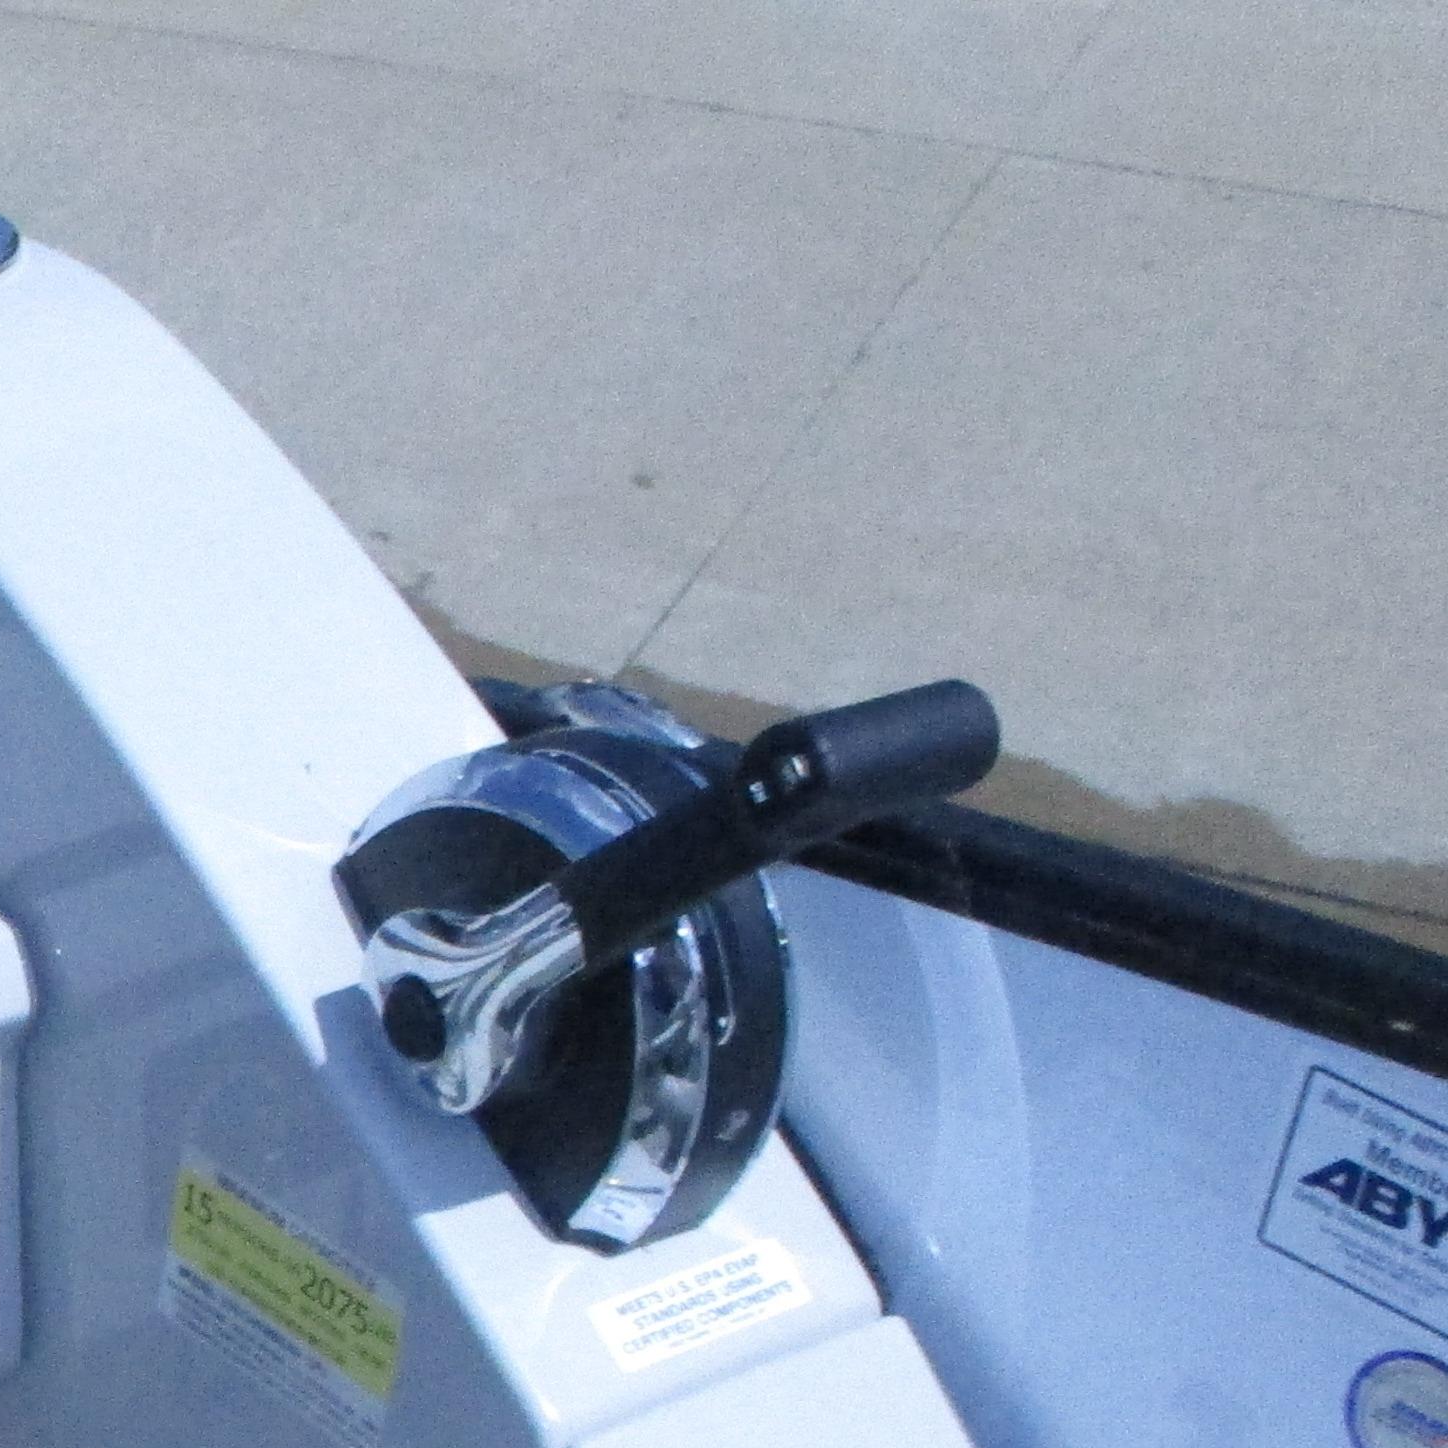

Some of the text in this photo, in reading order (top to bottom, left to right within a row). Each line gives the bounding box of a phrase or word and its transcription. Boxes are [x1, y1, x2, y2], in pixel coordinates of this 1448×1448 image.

[1365, 1137, 1448, 1198] Memb
[184, 1183, 213, 1226] 15
[300, 1263, 369, 1334] 2075
[694, 1268, 724, 1287] EPA
[622, 1319, 695, 1354] CERTIFIED
[697, 1280, 793, 1325] COMPONENTS
[633, 1289, 718, 1330] STANDARDS
